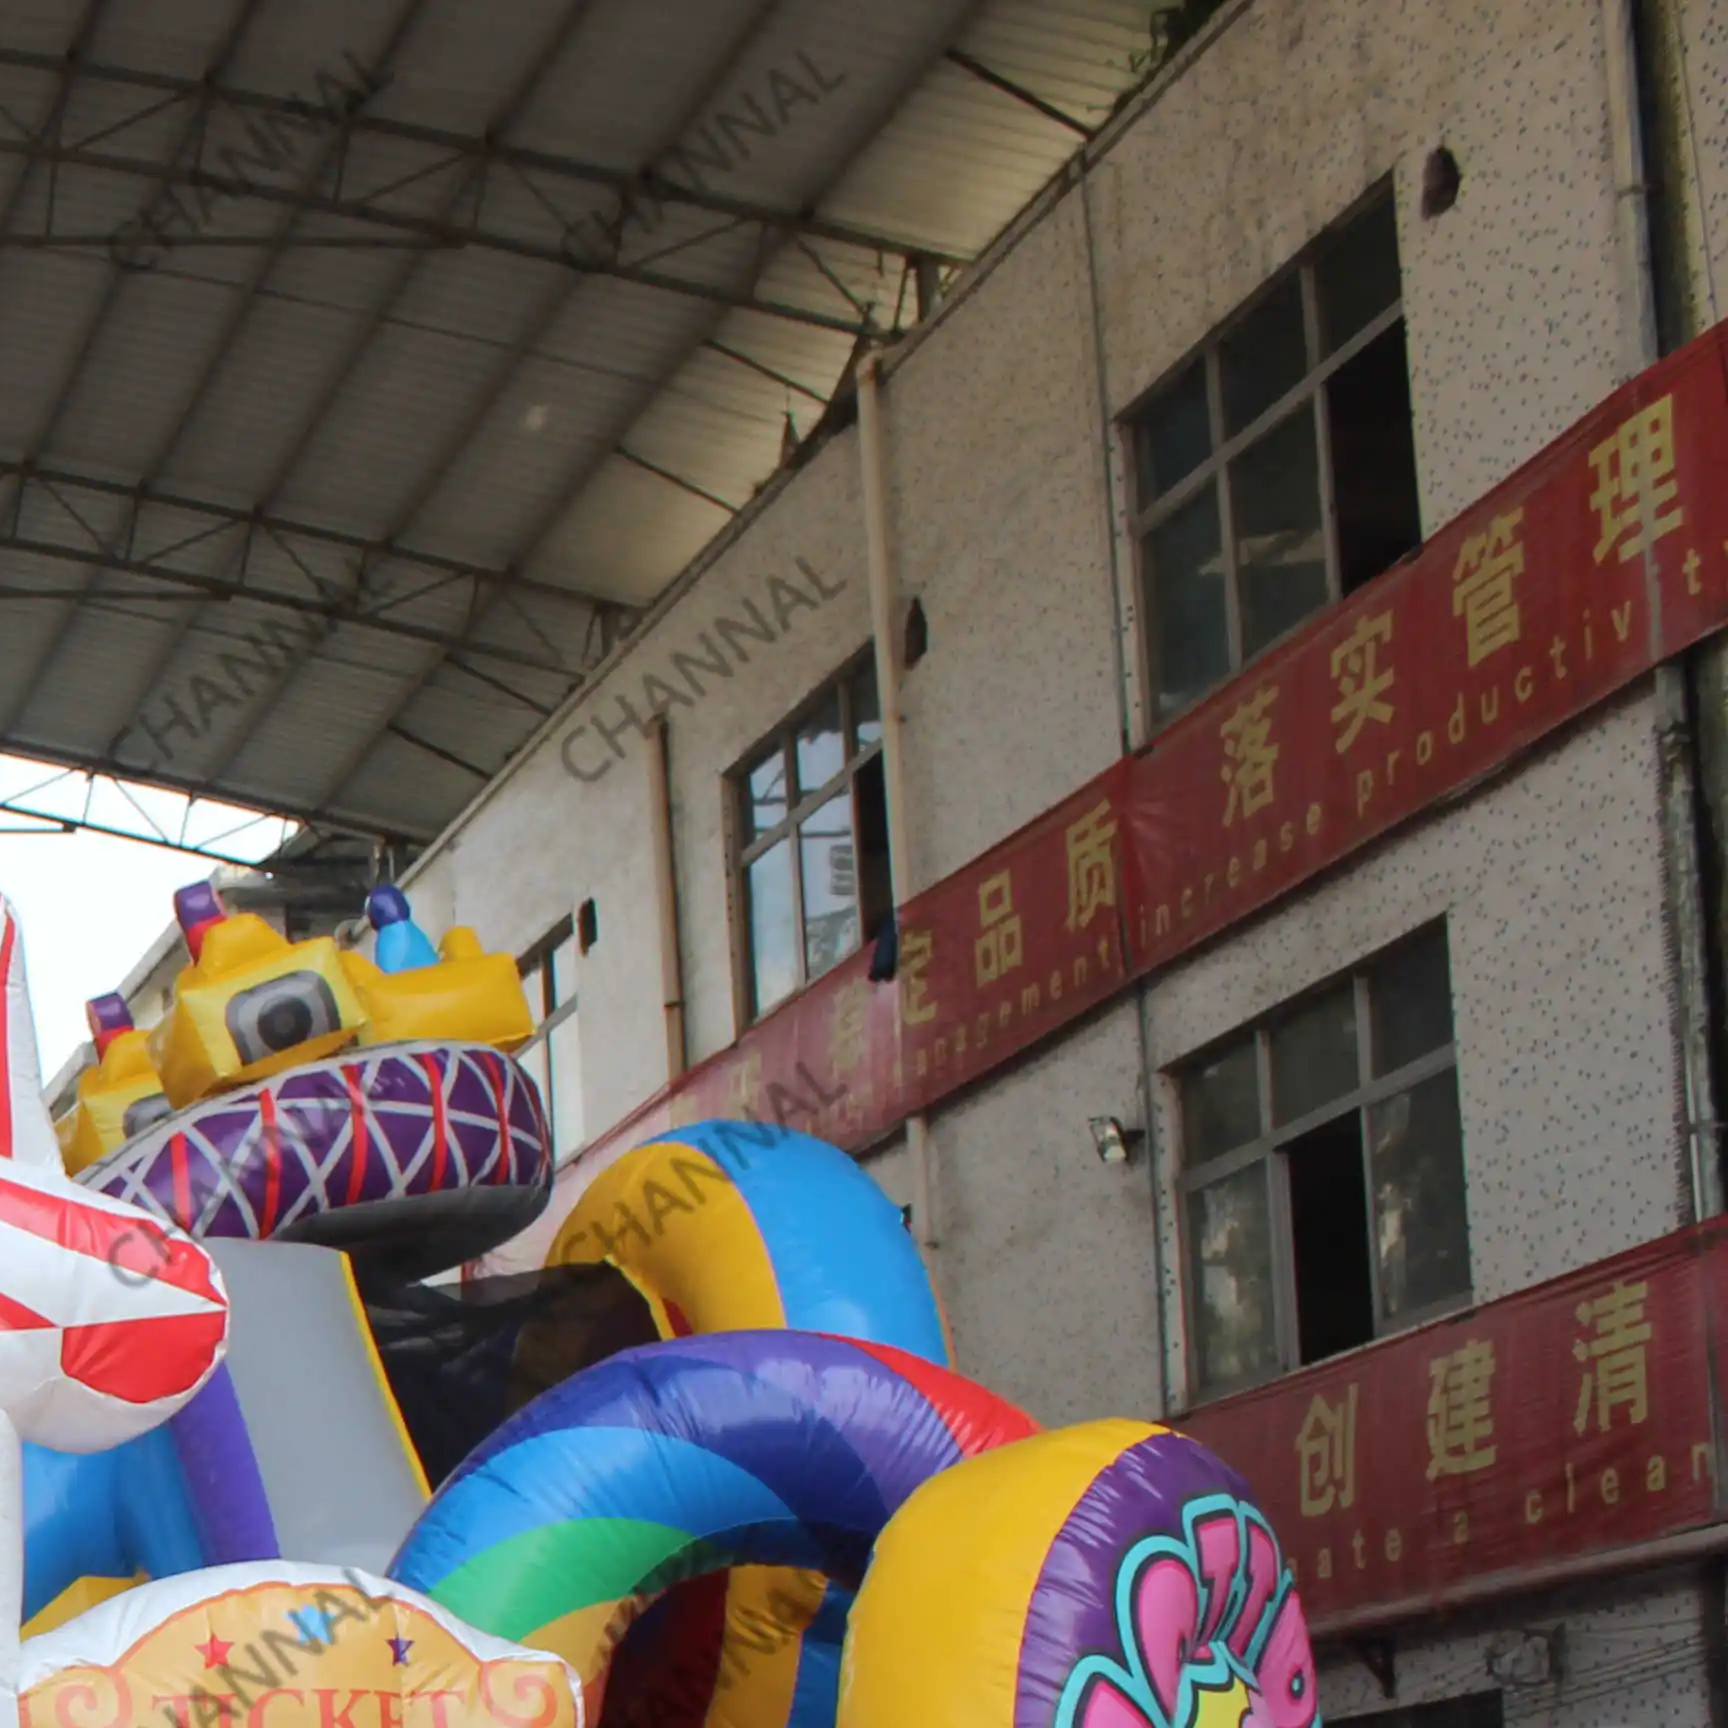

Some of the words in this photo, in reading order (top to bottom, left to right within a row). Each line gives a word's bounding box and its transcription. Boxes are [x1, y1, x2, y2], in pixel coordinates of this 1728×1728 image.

[1220, 393, 1683, 828] 落实管理
[1140, 802, 1322, 946] increase
[1453, 1510, 1470, 1544] a
[1525, 1441, 1714, 1524] clean
